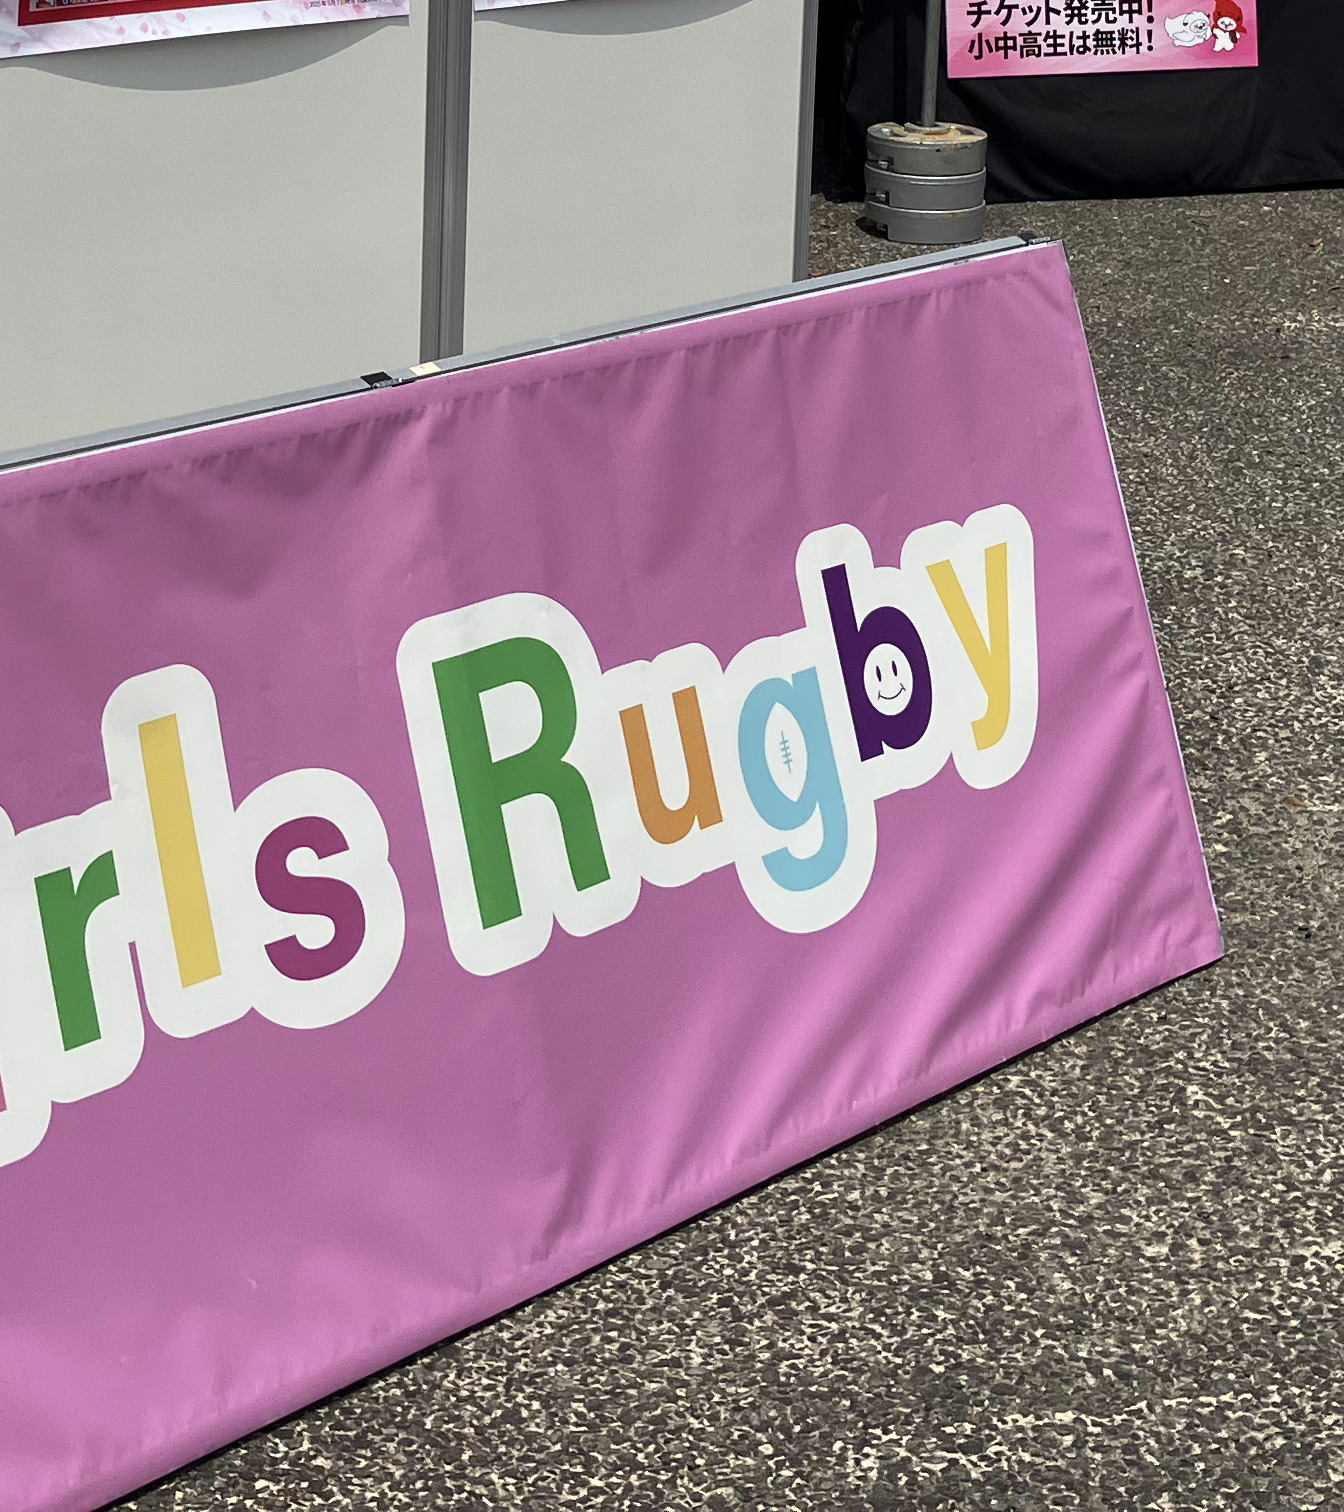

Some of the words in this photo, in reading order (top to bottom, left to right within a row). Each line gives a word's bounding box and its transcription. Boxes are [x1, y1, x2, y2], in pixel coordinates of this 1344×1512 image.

[967, 27, 1154, 60] 小中高生は無料!
[431, 542, 1010, 930] Rugby
